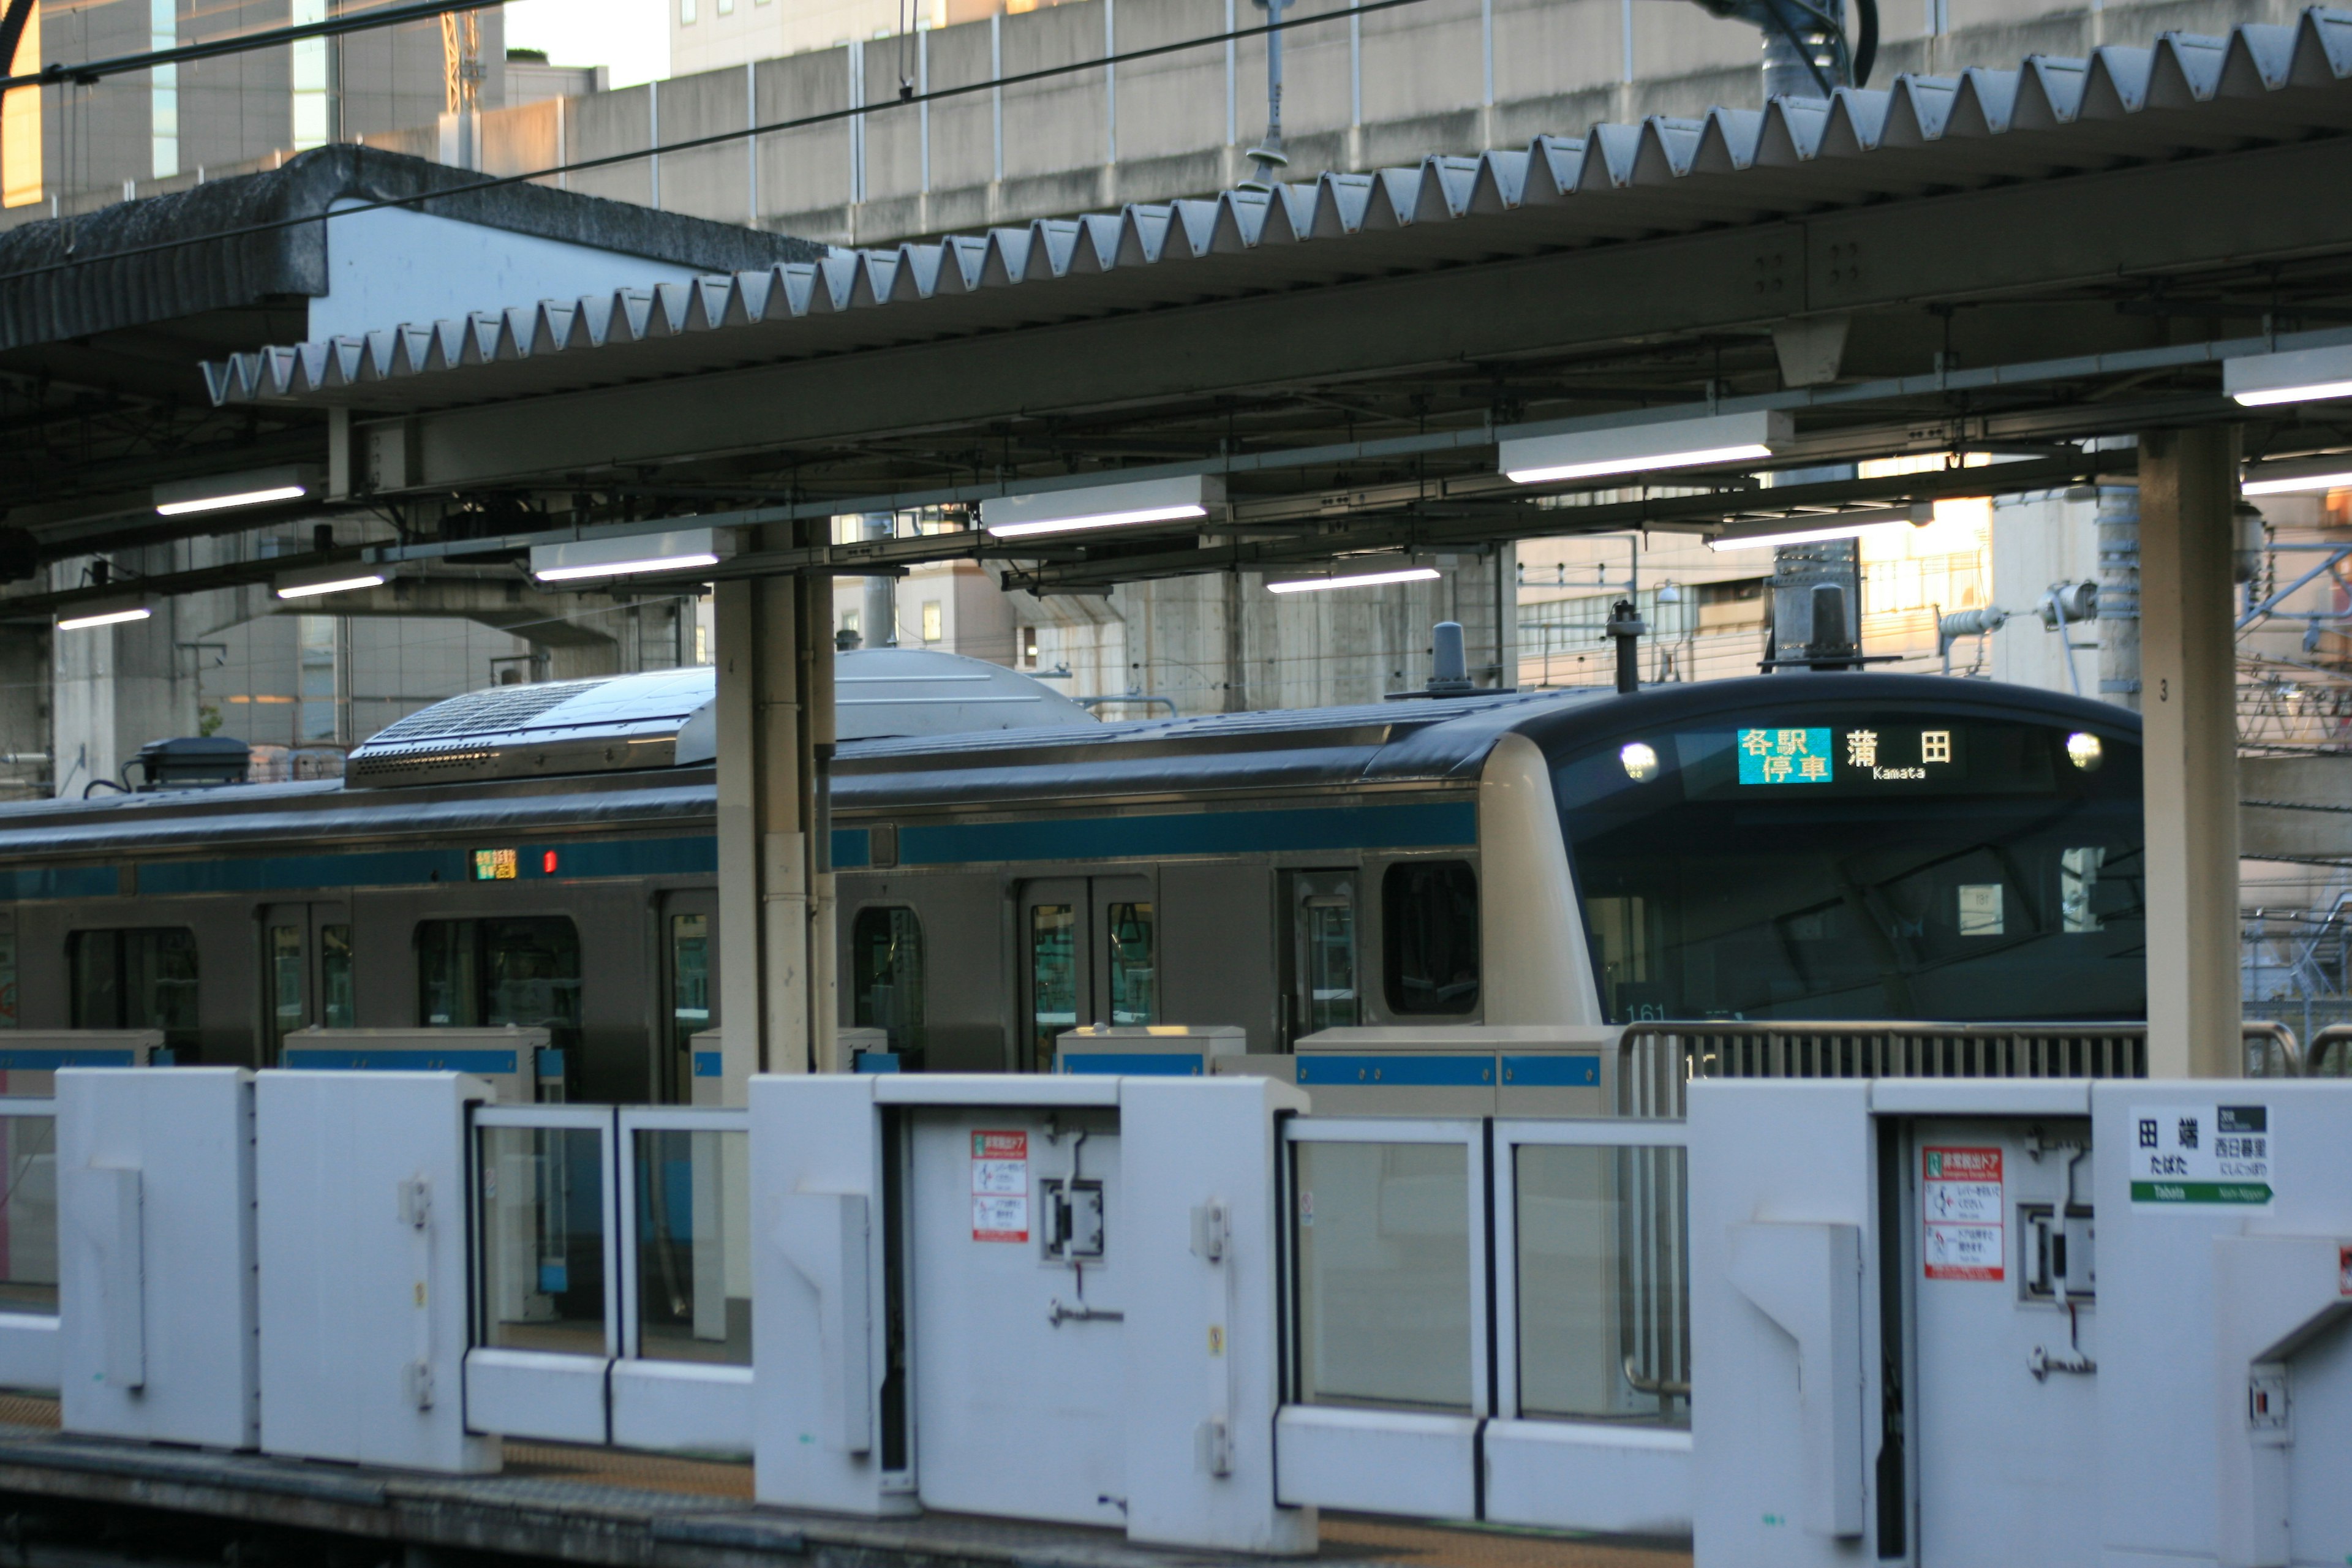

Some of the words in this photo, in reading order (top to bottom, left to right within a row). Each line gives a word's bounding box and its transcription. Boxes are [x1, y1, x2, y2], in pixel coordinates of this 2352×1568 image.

[2160, 678, 2168, 702] 3
[1742, 729, 1808, 756] 各駅
[1762, 755, 1828, 783] 停車
[1873, 766, 1926, 780] Kamata
[1626, 1004, 1664, 1021] 161
[2139, 1117, 2198, 1149] 田端
[2215, 1137, 2266, 1158] 西日暮里
[1943, 1153, 1999, 1170] 非常脱出ドア
[2150, 1154, 2188, 1175] たばた
[2220, 1163, 2267, 1176] にしにっぽり
[2154, 1185, 2186, 1199] Tabata
